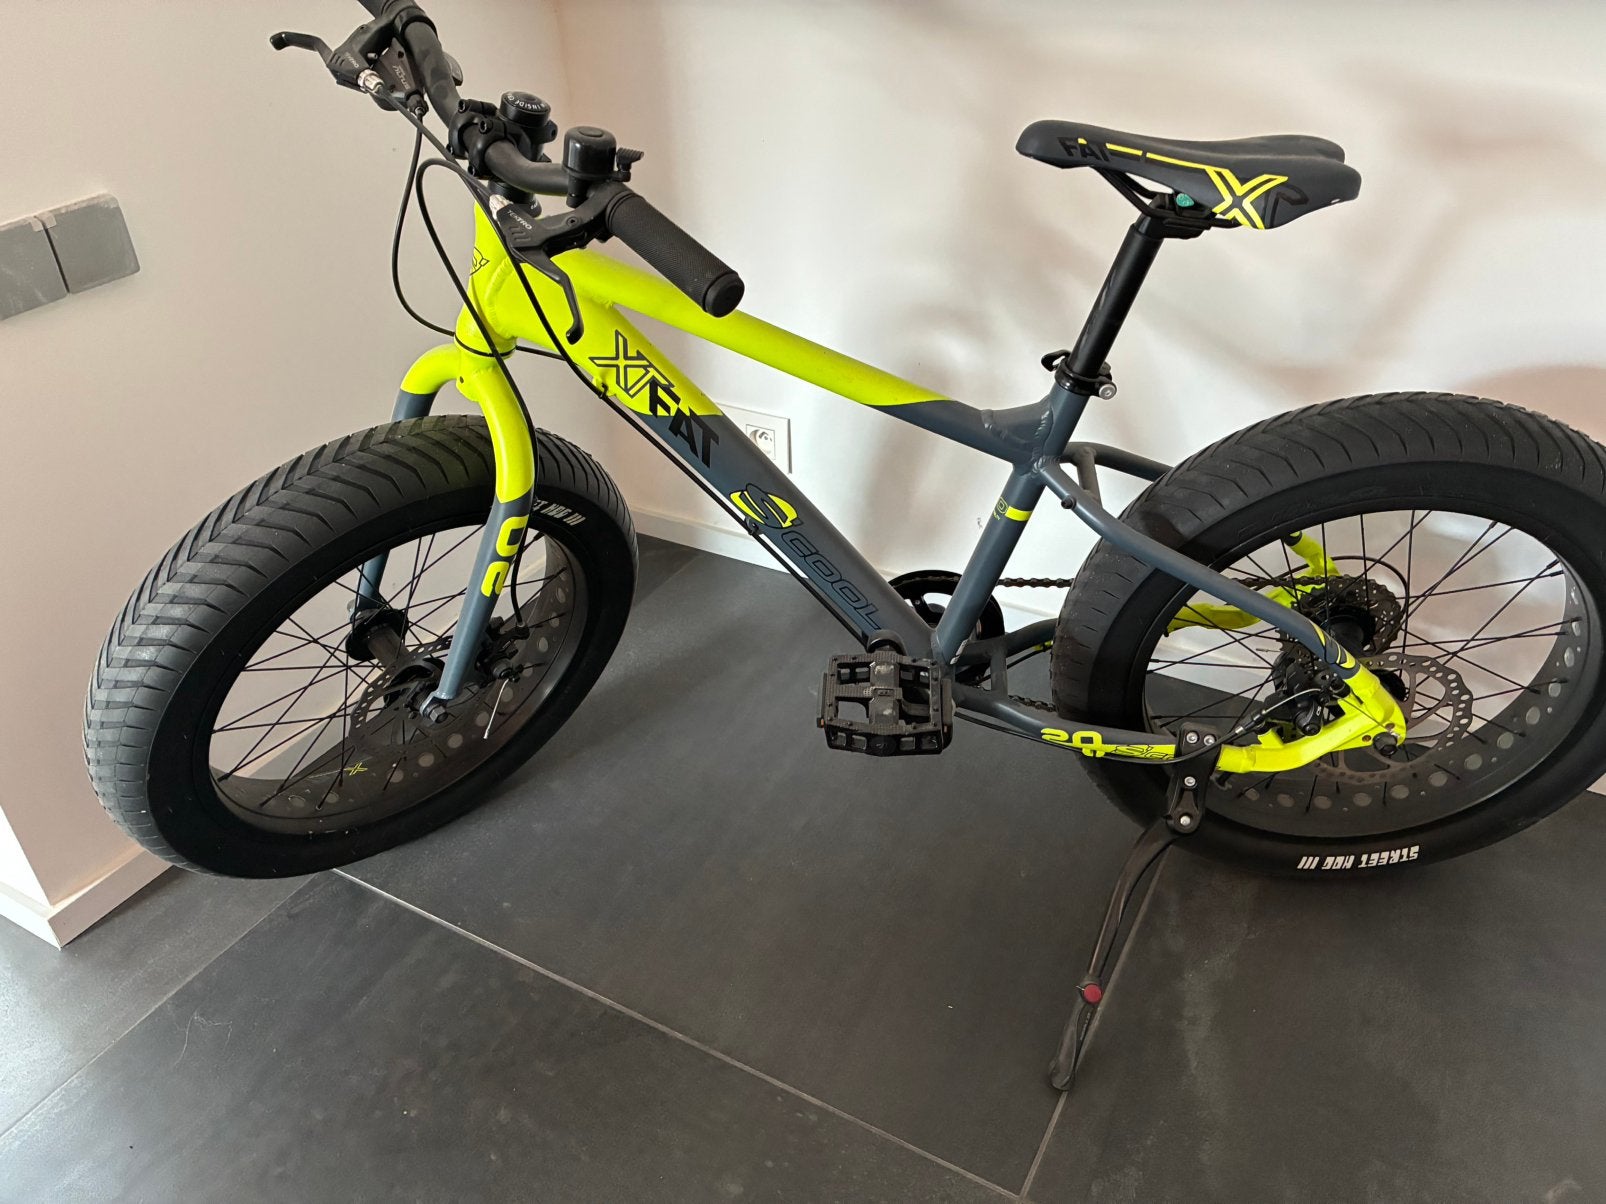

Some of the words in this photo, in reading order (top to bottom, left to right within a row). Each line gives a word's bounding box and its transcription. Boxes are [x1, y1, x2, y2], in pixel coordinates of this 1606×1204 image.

[507, 209, 532, 230] TEKTRO
[1321, 855, 1356, 870] HOG
[1357, 845, 1420, 869] STREET
